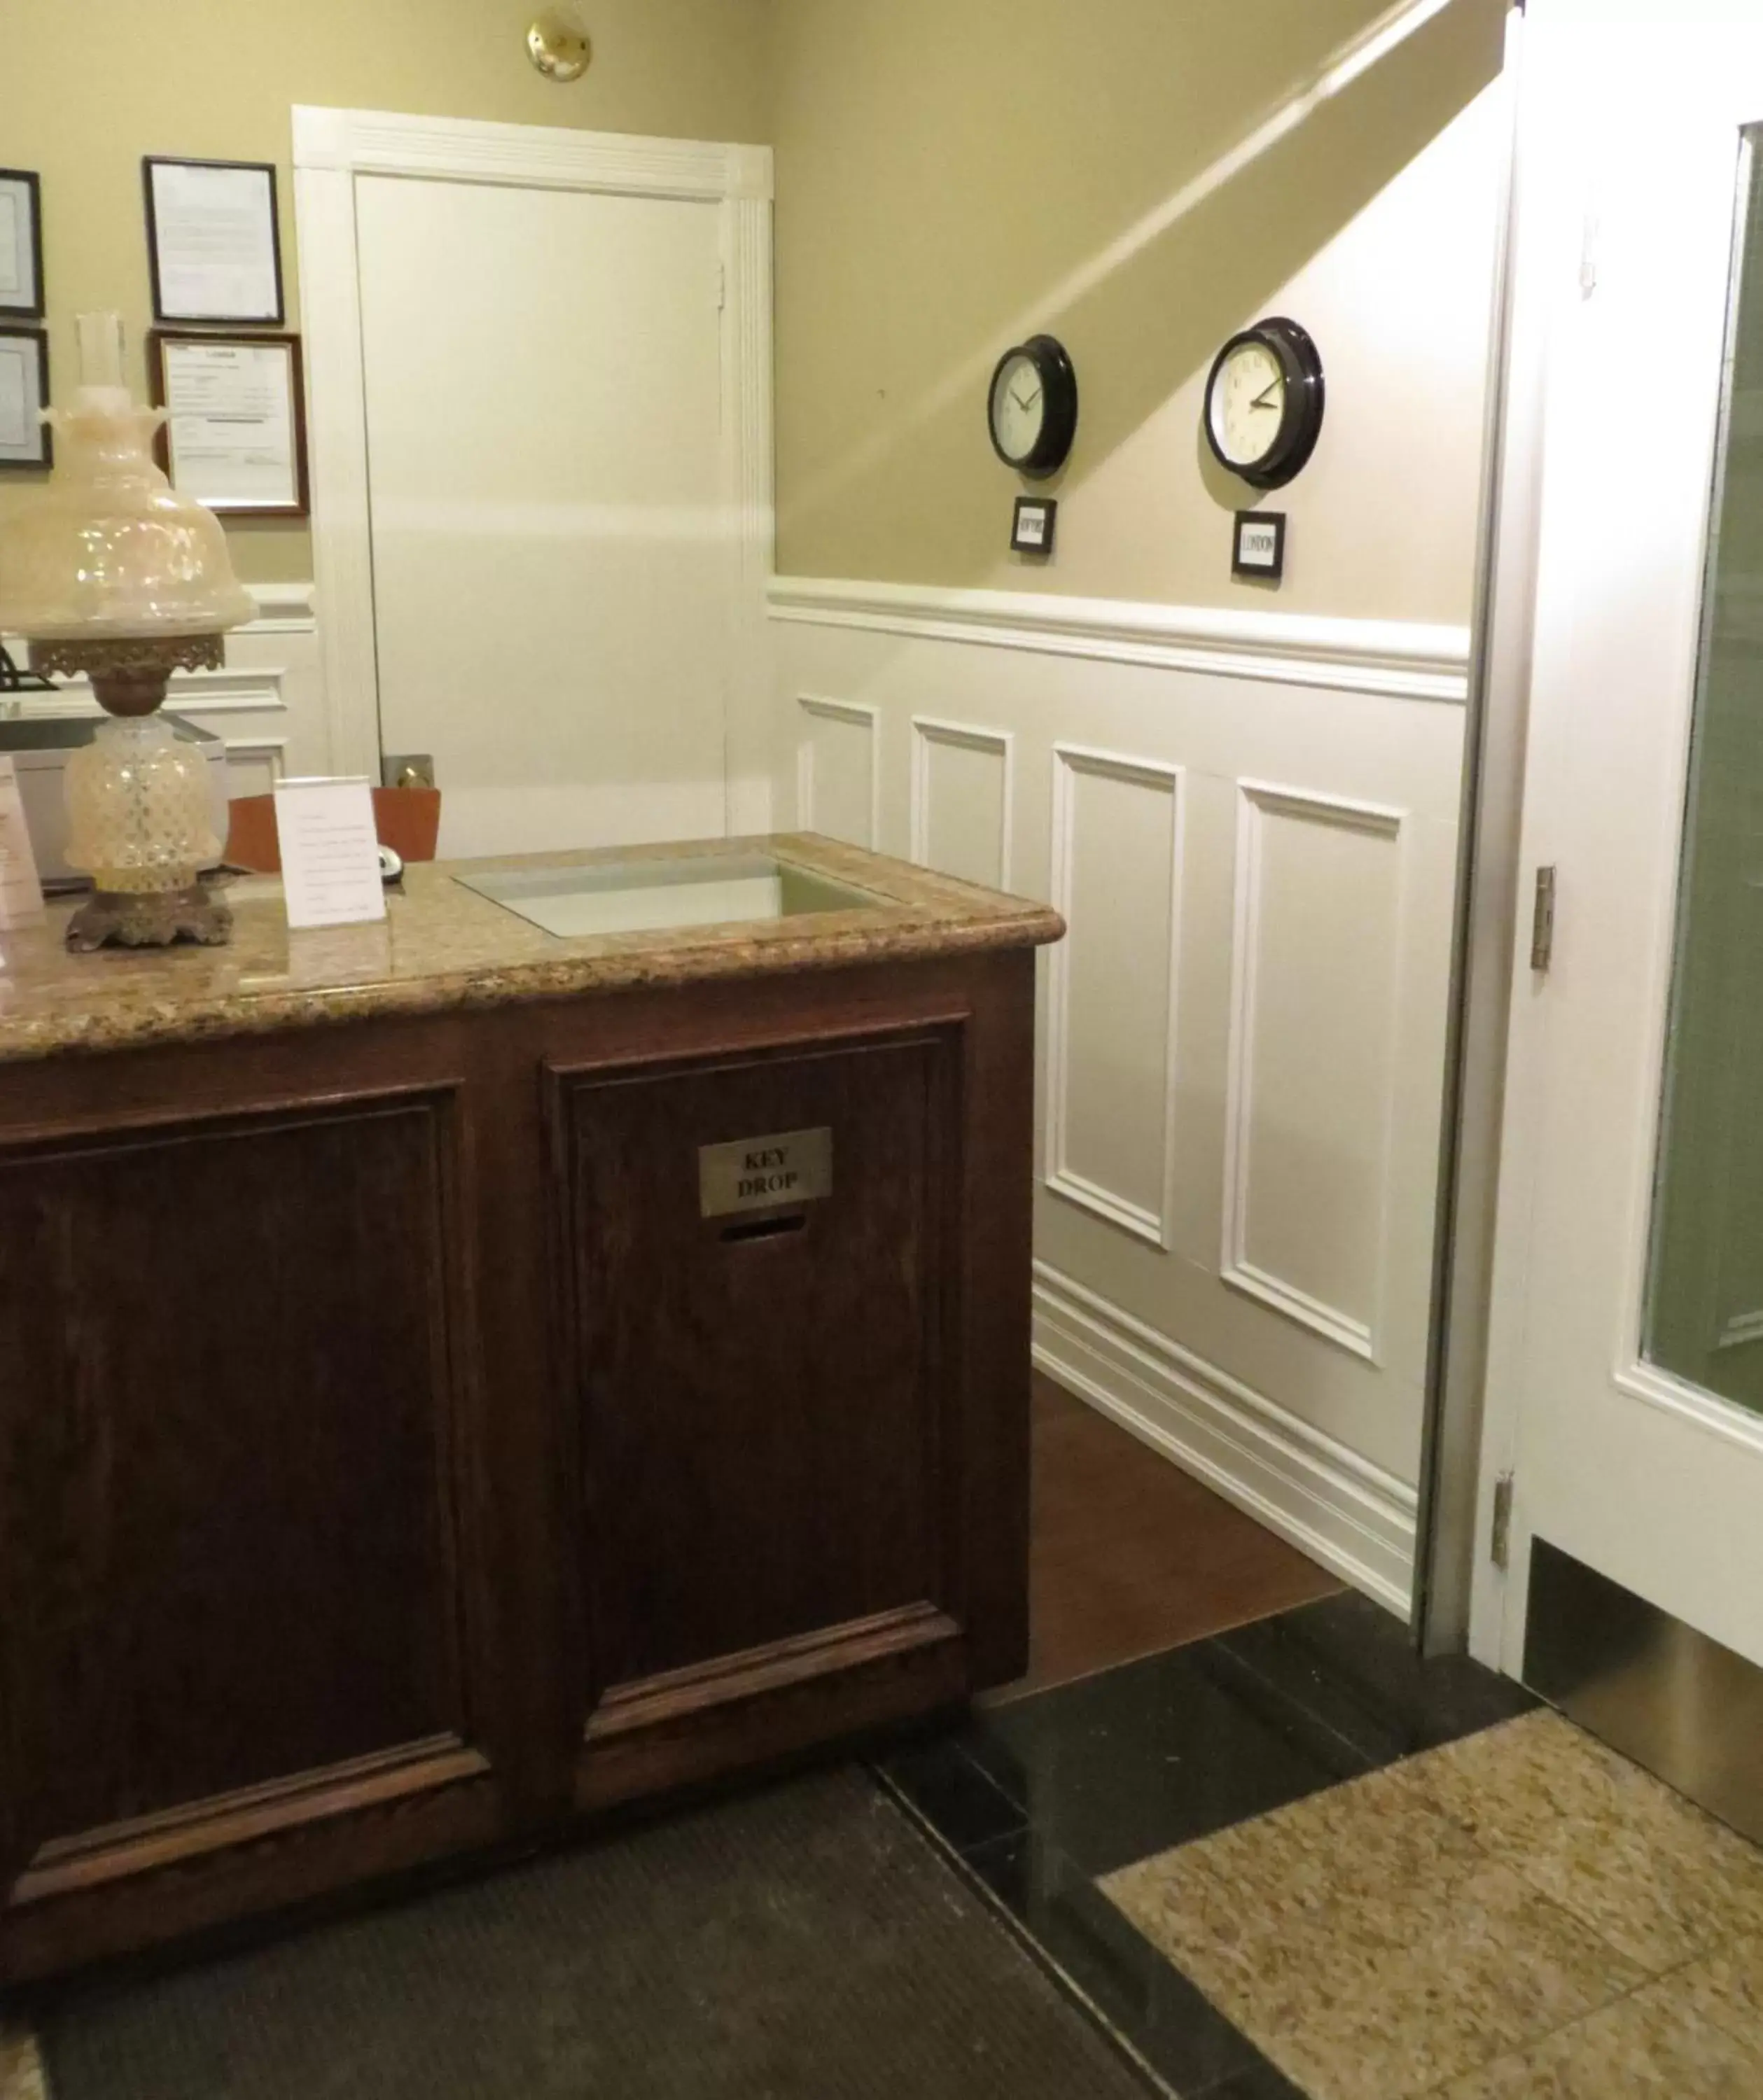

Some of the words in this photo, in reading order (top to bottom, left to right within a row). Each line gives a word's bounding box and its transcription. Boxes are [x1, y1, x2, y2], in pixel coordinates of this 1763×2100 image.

[1242, 533, 1274, 552] LONDON
[745, 1146, 789, 1170] KEY
[737, 1171, 799, 1199] DROP
